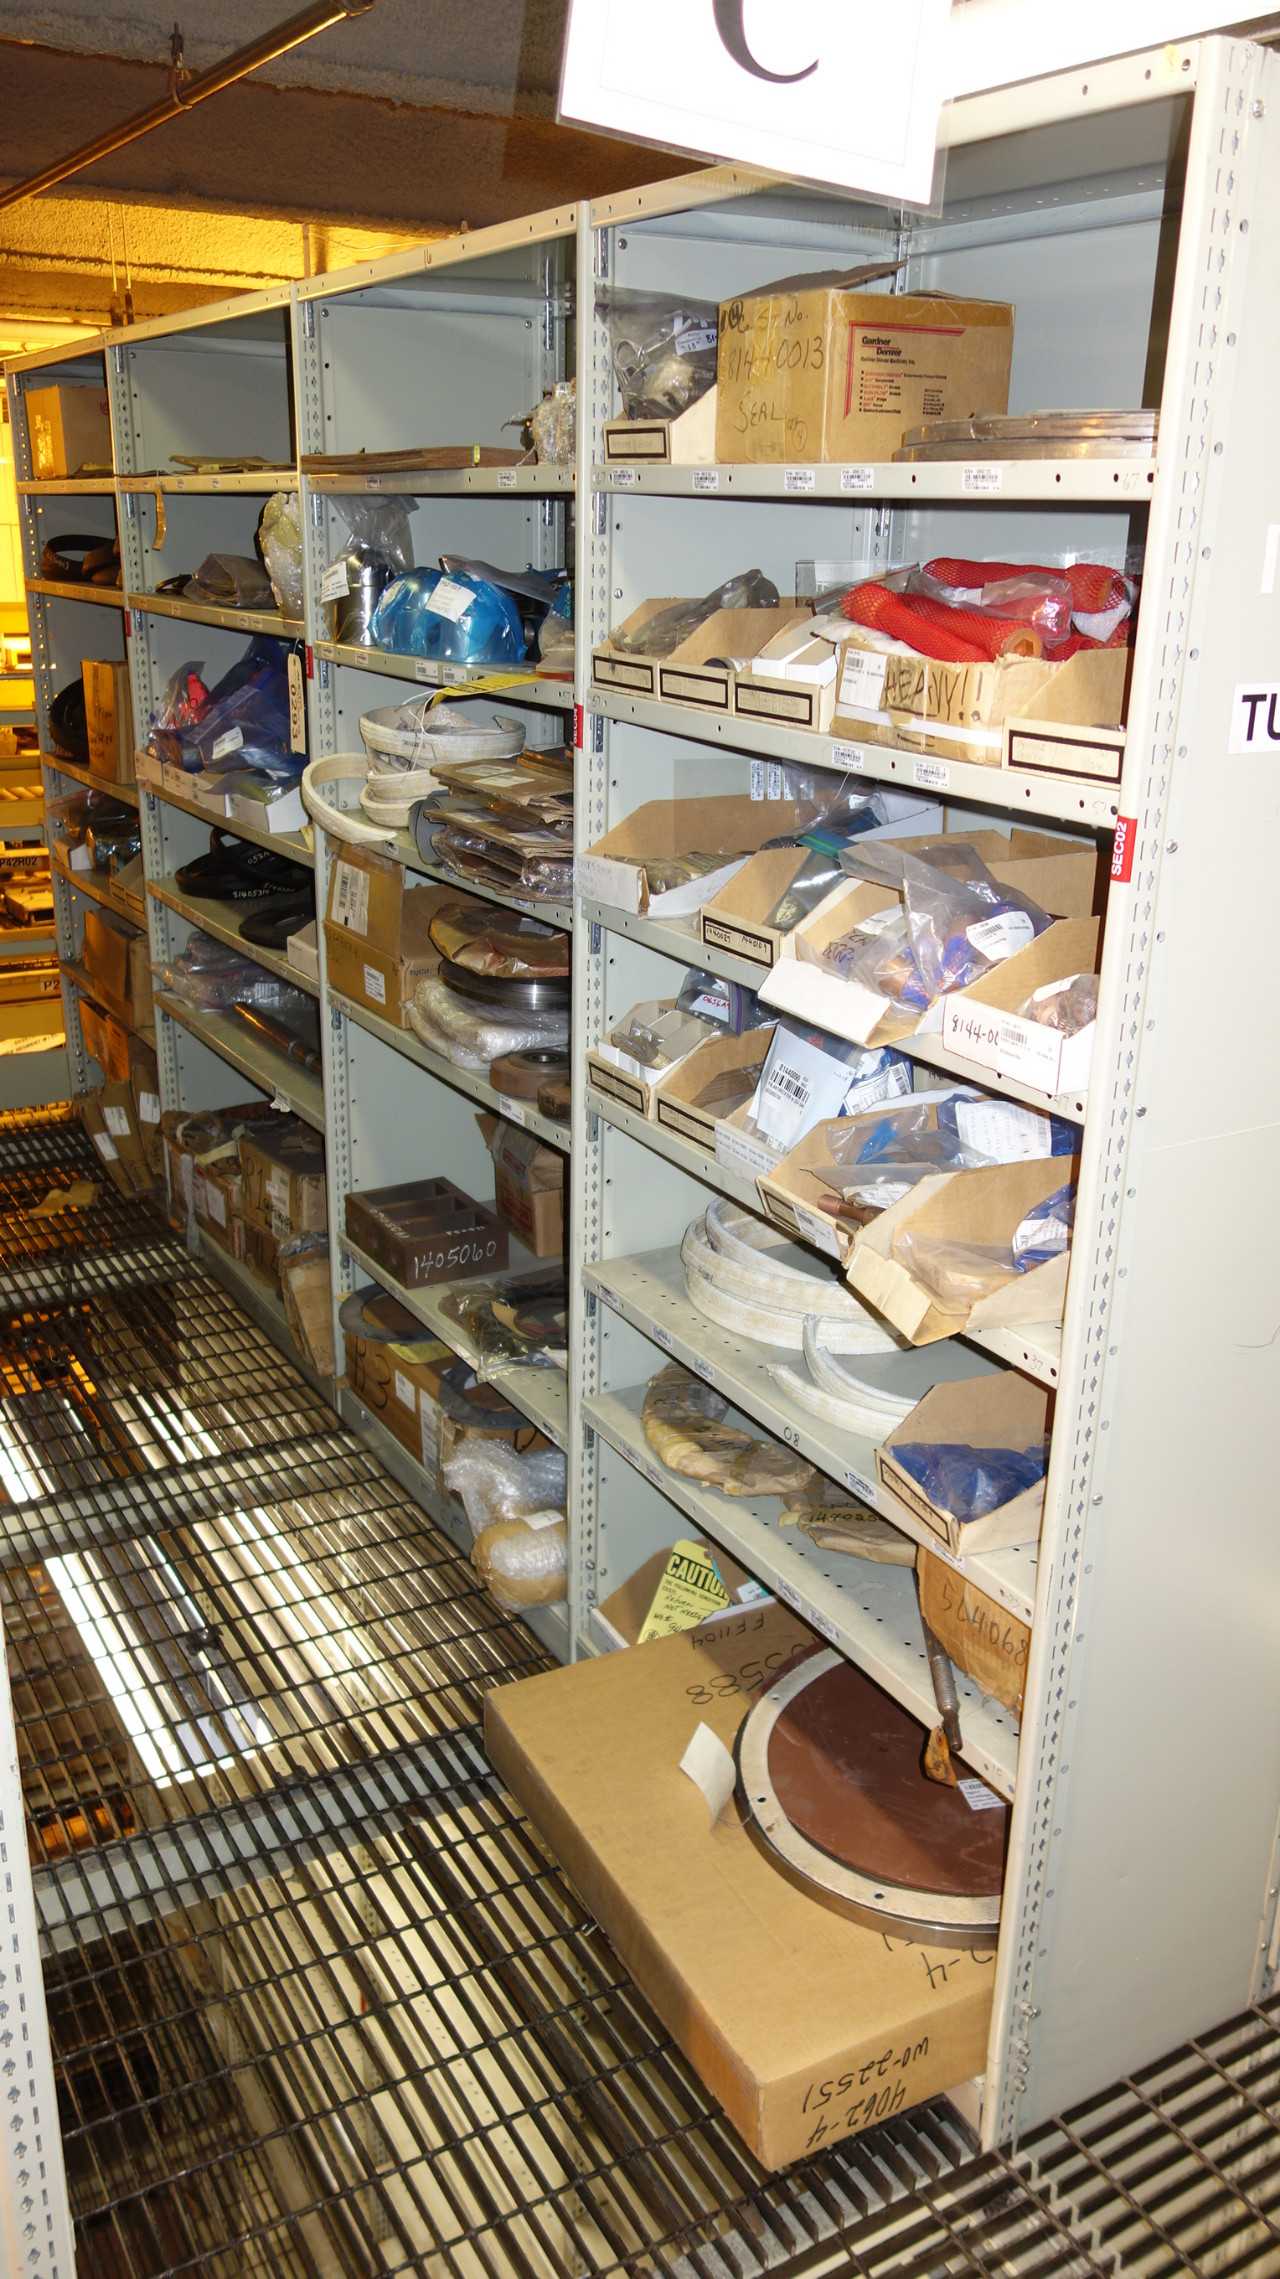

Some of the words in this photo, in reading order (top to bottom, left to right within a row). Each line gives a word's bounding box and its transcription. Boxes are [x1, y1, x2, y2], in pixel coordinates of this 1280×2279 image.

[862, 336, 892, 346] Gardner
[734, 399, 786, 433] SEAL
[1111, 821, 1128, 876] SEC02
[413, 1240, 497, 1280] 1405060
[666, 1555, 729, 1600] CAUTIO
[805, 2079, 907, 2149] 4062-4
